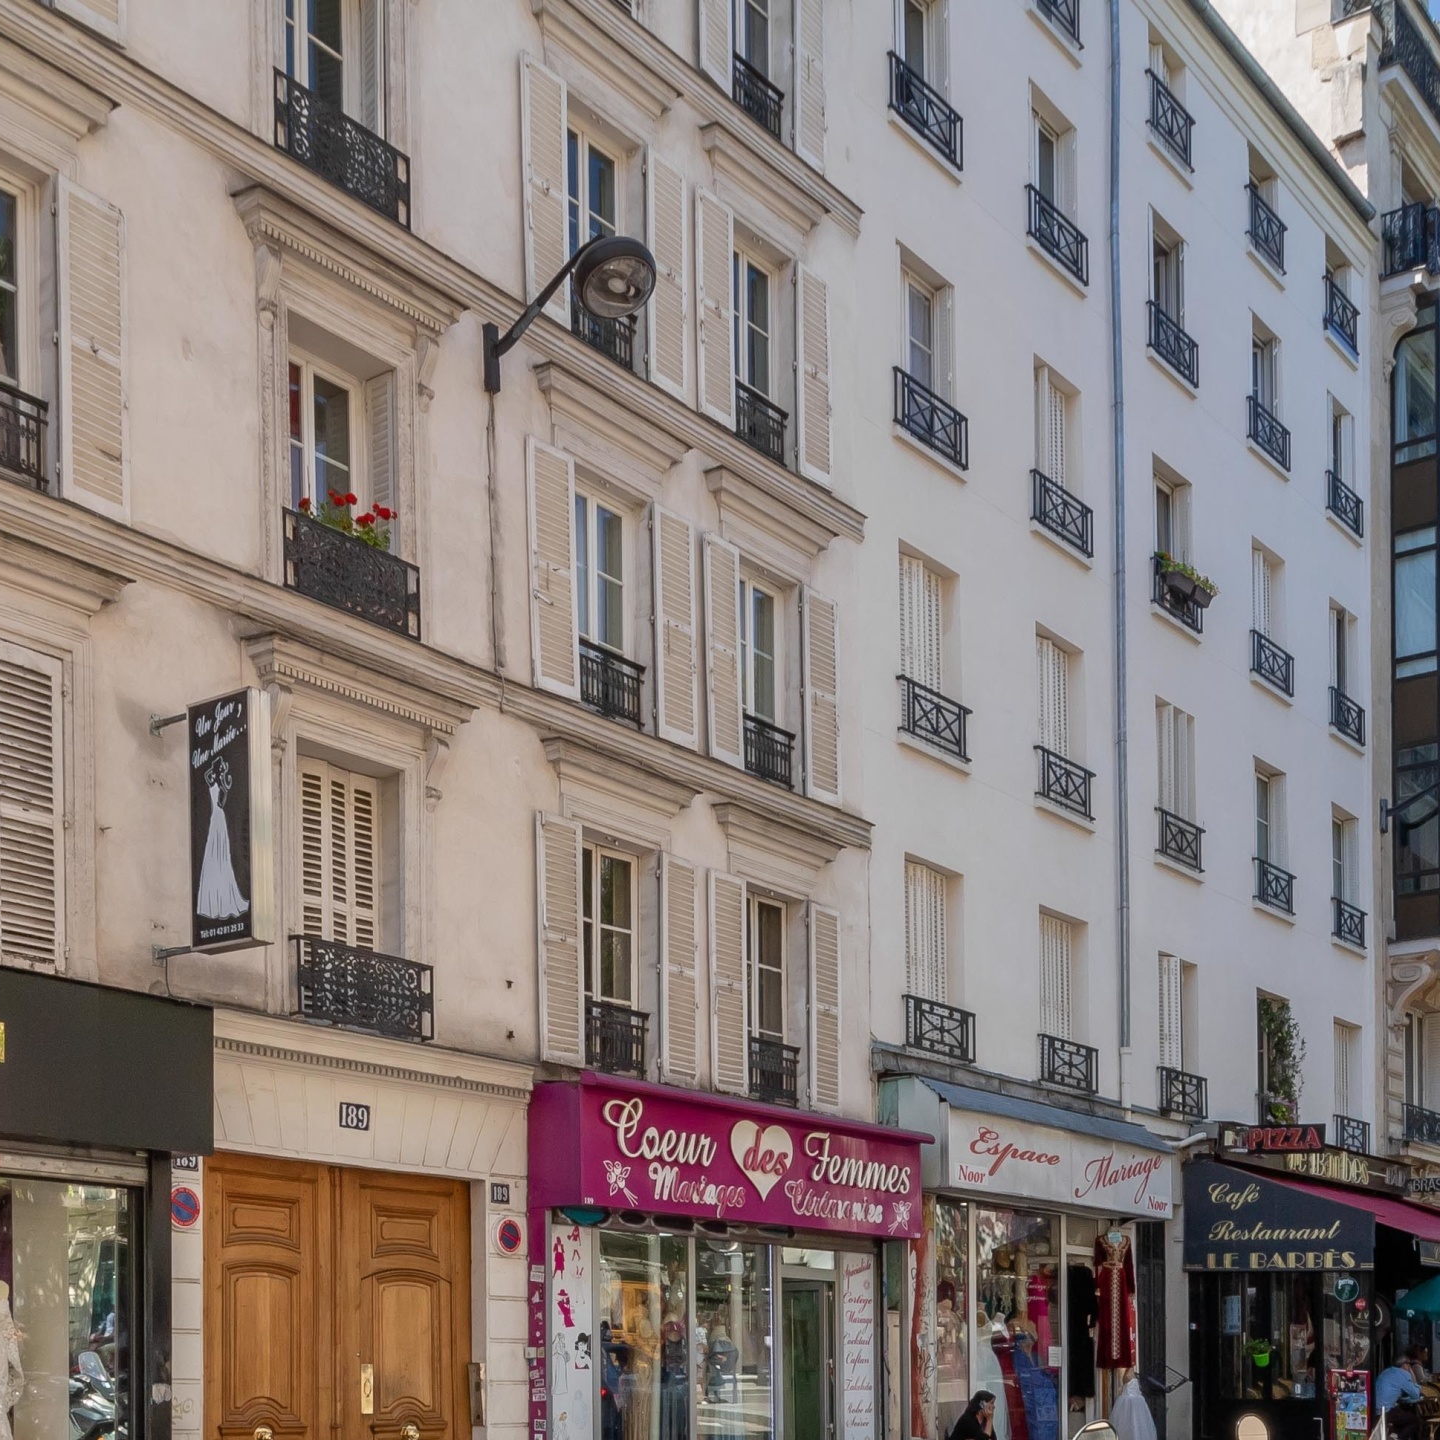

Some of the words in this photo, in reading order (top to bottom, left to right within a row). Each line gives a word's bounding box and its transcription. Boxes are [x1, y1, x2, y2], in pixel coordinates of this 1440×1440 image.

[195, 714, 212, 737] Un
[192, 748, 210, 769] Une
[340, 1103, 368, 1129] 189
[602, 1097, 718, 1168] Coeur
[742, 1126, 790, 1176] des
[804, 1131, 911, 1195] Femmes
[1248, 1127, 1321, 1150] PIZZA
[957, 1163, 986, 1185] Noor
[969, 1126, 1061, 1176] Espace
[1074, 1150, 1163, 1204] Mariage
[493, 1185, 508, 1202] 189
[648, 1161, 746, 1218] Mariages
[1208, 1183, 1260, 1210] Café
[1147, 1195, 1168, 1212] Noor
[1208, 1219, 1342, 1242] Restaurant
[1207, 1252, 1239, 1269] LE
[1249, 1248, 1356, 1269] BARBÈS
